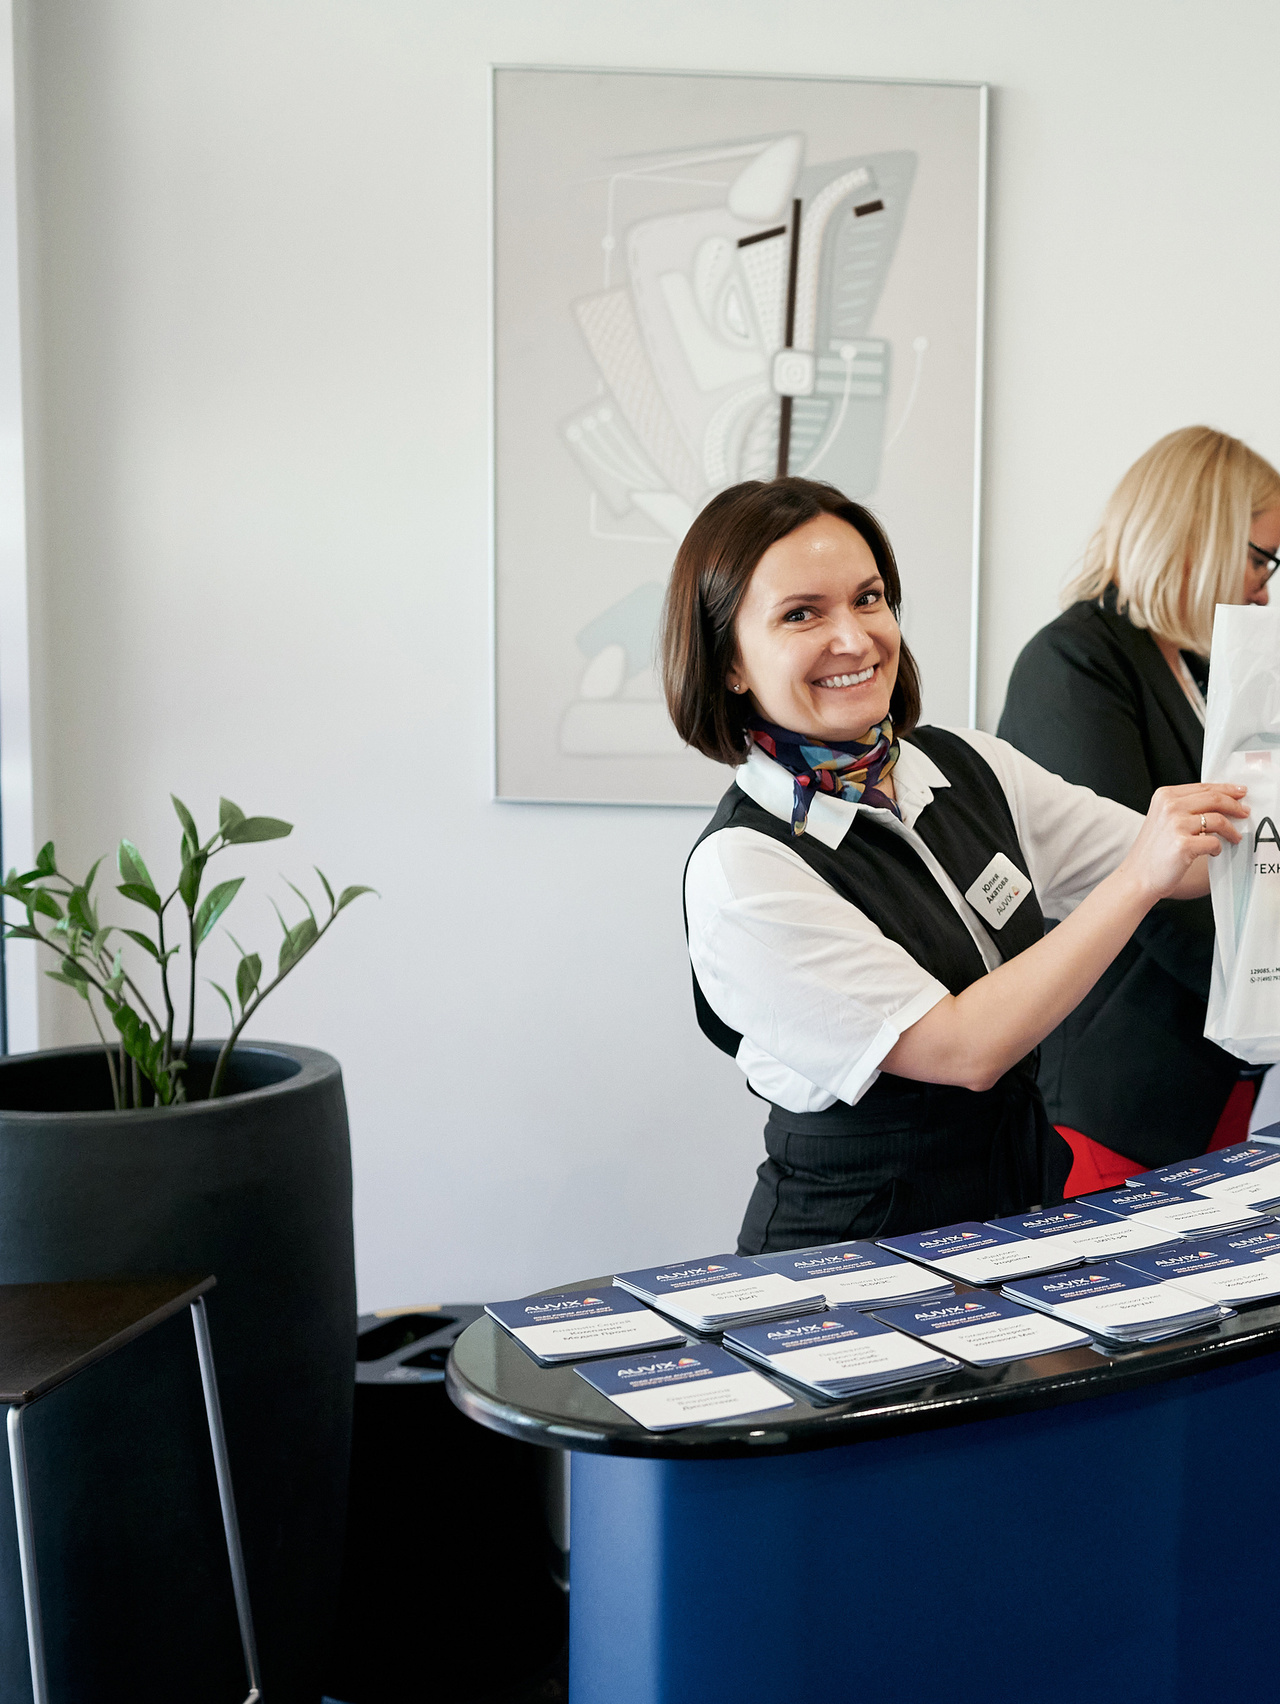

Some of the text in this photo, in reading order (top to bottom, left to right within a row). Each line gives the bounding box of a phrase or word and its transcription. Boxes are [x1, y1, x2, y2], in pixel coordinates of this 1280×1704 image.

[981, 873, 1000, 894] Юлия
[986, 876, 1009, 904] Акатова
[996, 893, 1015, 915] AUVIX
[1223, 1150, 1252, 1163] AUVIX
[1160, 1170, 1191, 1182] AUVIX
[1112, 1192, 1152, 1204] AUVIX
[1022, 1215, 1064, 1228] AUVIX
[919, 1234, 963, 1248] AUVIX
[1228, 1236, 1268, 1248] AUVIX
[794, 1255, 843, 1268] AUVIX
[1155, 1254, 1200, 1266] AUVIX
[656, 1267, 707, 1281] AUVIX
[1042, 1278, 1090, 1291] AUVIX
[525, 1299, 582, 1313] AUVIX
[914, 1305, 965, 1320] AUVIX
[767, 1323, 822, 1339] AUVIX
[618, 1361, 677, 1377] AUVIX
